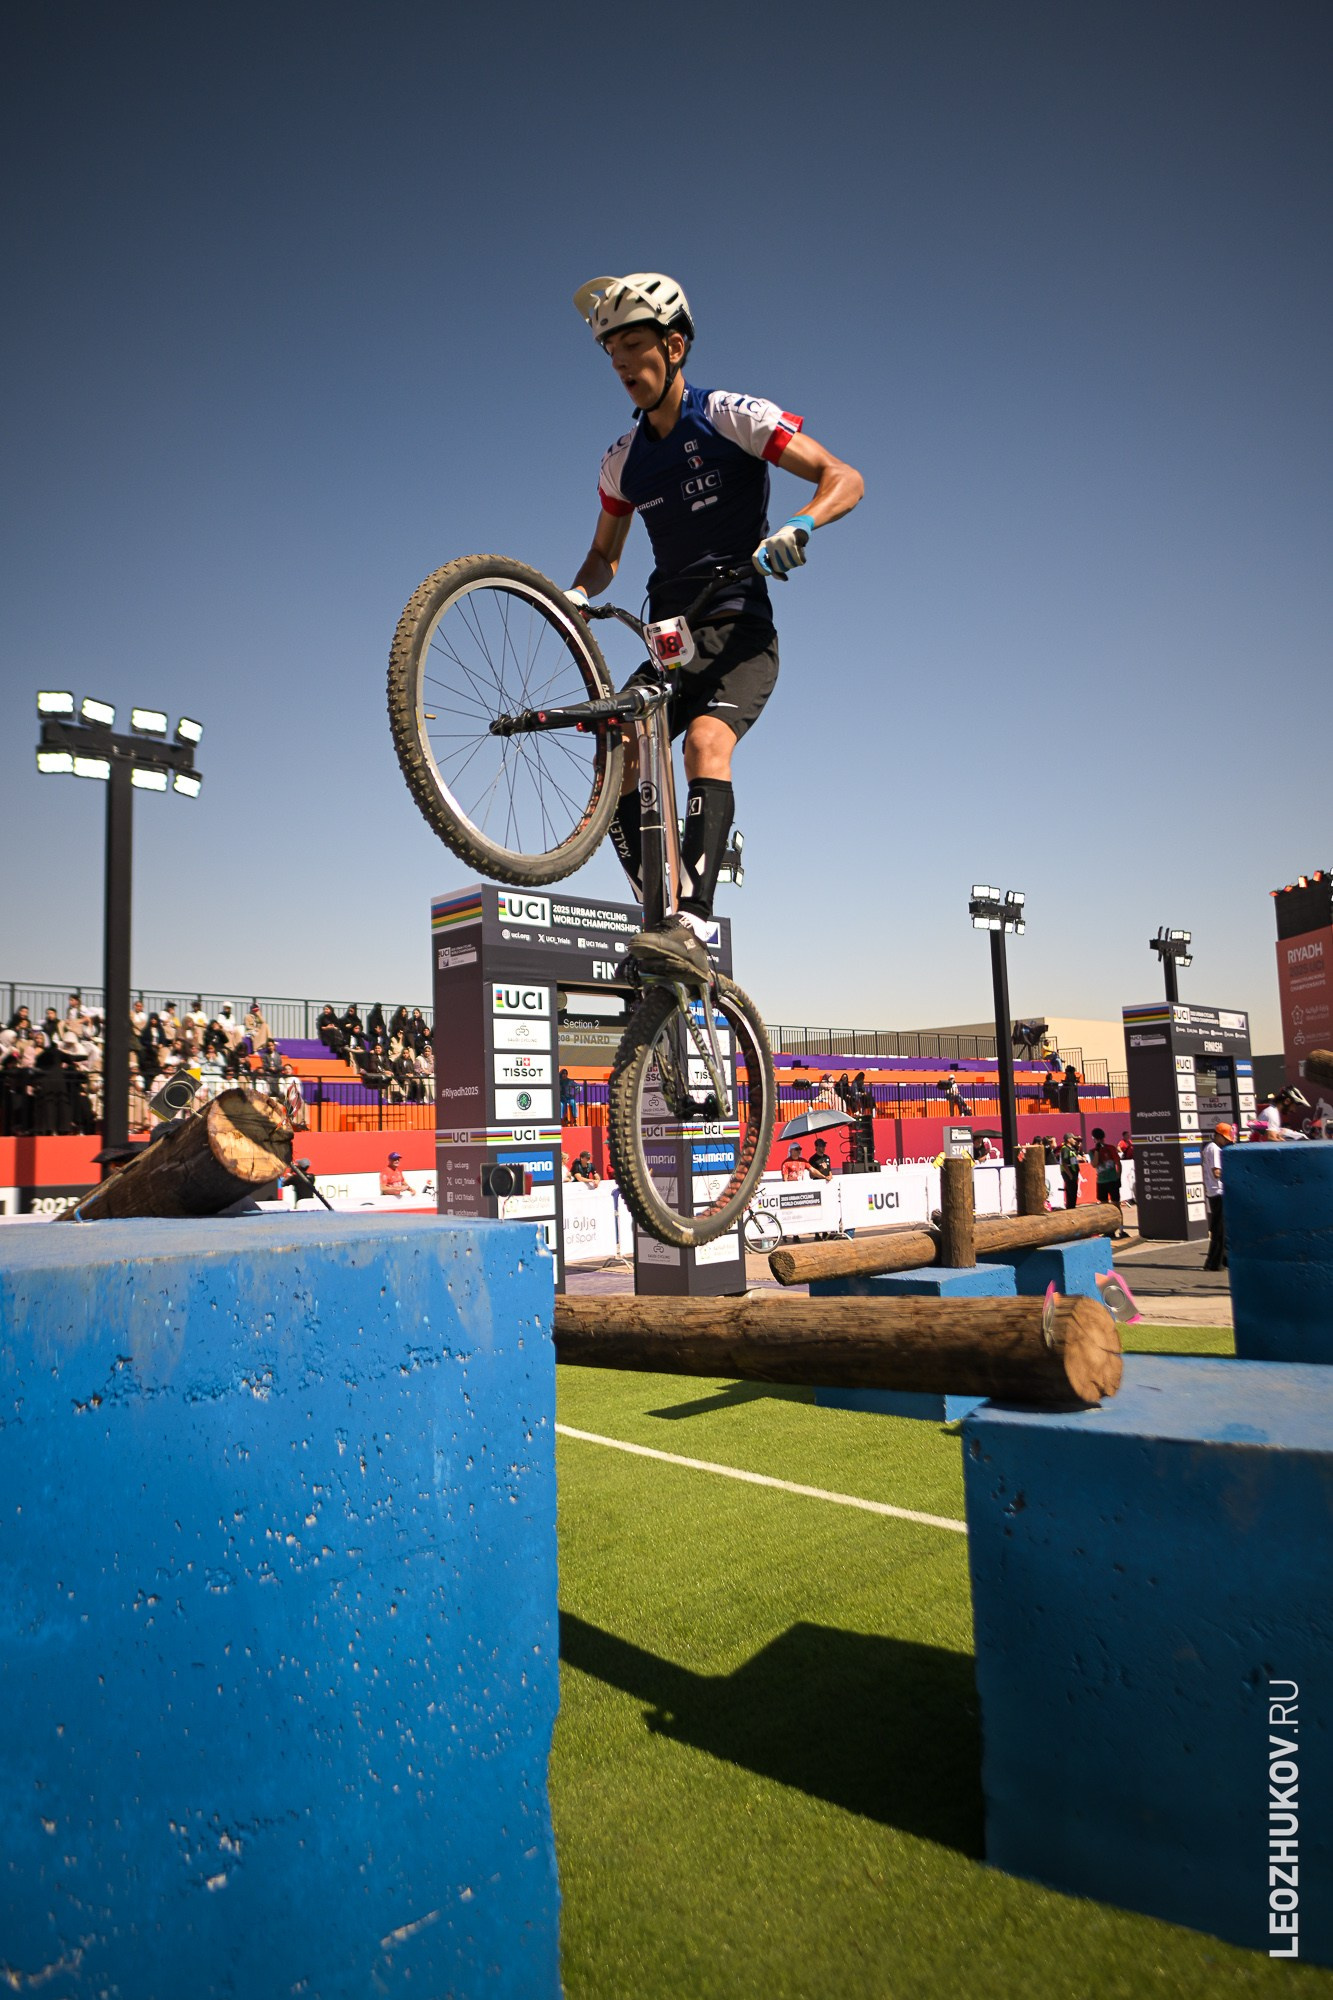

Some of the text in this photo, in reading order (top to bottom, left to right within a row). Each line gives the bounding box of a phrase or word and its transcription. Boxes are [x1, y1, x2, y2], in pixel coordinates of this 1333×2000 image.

[685, 474, 717, 494] CIC
[507, 899, 546, 920] UCI
[552, 904, 628, 922] 2025 URBAN CYCLING
[553, 914, 641, 933] WORLD CHAMPIONSHIPS
[511, 932, 531, 941] uci.org
[545, 936, 571, 945] UCI_Trials
[585, 940, 609, 950] UCI Trials
[1287, 942, 1324, 964] RIYADH
[592, 960, 619, 980] FIN
[505, 990, 543, 1010] UCI
[1177, 1010, 1189, 1021] UCI
[563, 1019, 600, 1030] Section 2
[573, 1034, 610, 1045] PINARD
[1204, 1041, 1223, 1052] FINISH
[1180, 1059, 1192, 1069] UCI
[502, 1067, 544, 1077] TISSOT
[441, 1086, 479, 1099] #Riyadh2025
[513, 1129, 536, 1141] UCI
[646, 1127, 663, 1137] UCI
[704, 1125, 721, 1135] UCI
[452, 1132, 468, 1143] UCI
[1147, 1135, 1164, 1143] UCI
[952, 1145, 972, 1156] START
[645, 1155, 676, 1164] IMANO
[692, 1152, 734, 1164] SHIMANO
[454, 1162, 469, 1170] uci.org
[454, 1179, 475, 1187] UCI_Trials
[1190, 1187, 1202, 1199] UCI
[762, 1198, 779, 1208] UCI
[874, 1191, 899, 1210] UCI
[572, 1215, 597, 1231] وزارة
[575, 1232, 597, 1244] Sport
